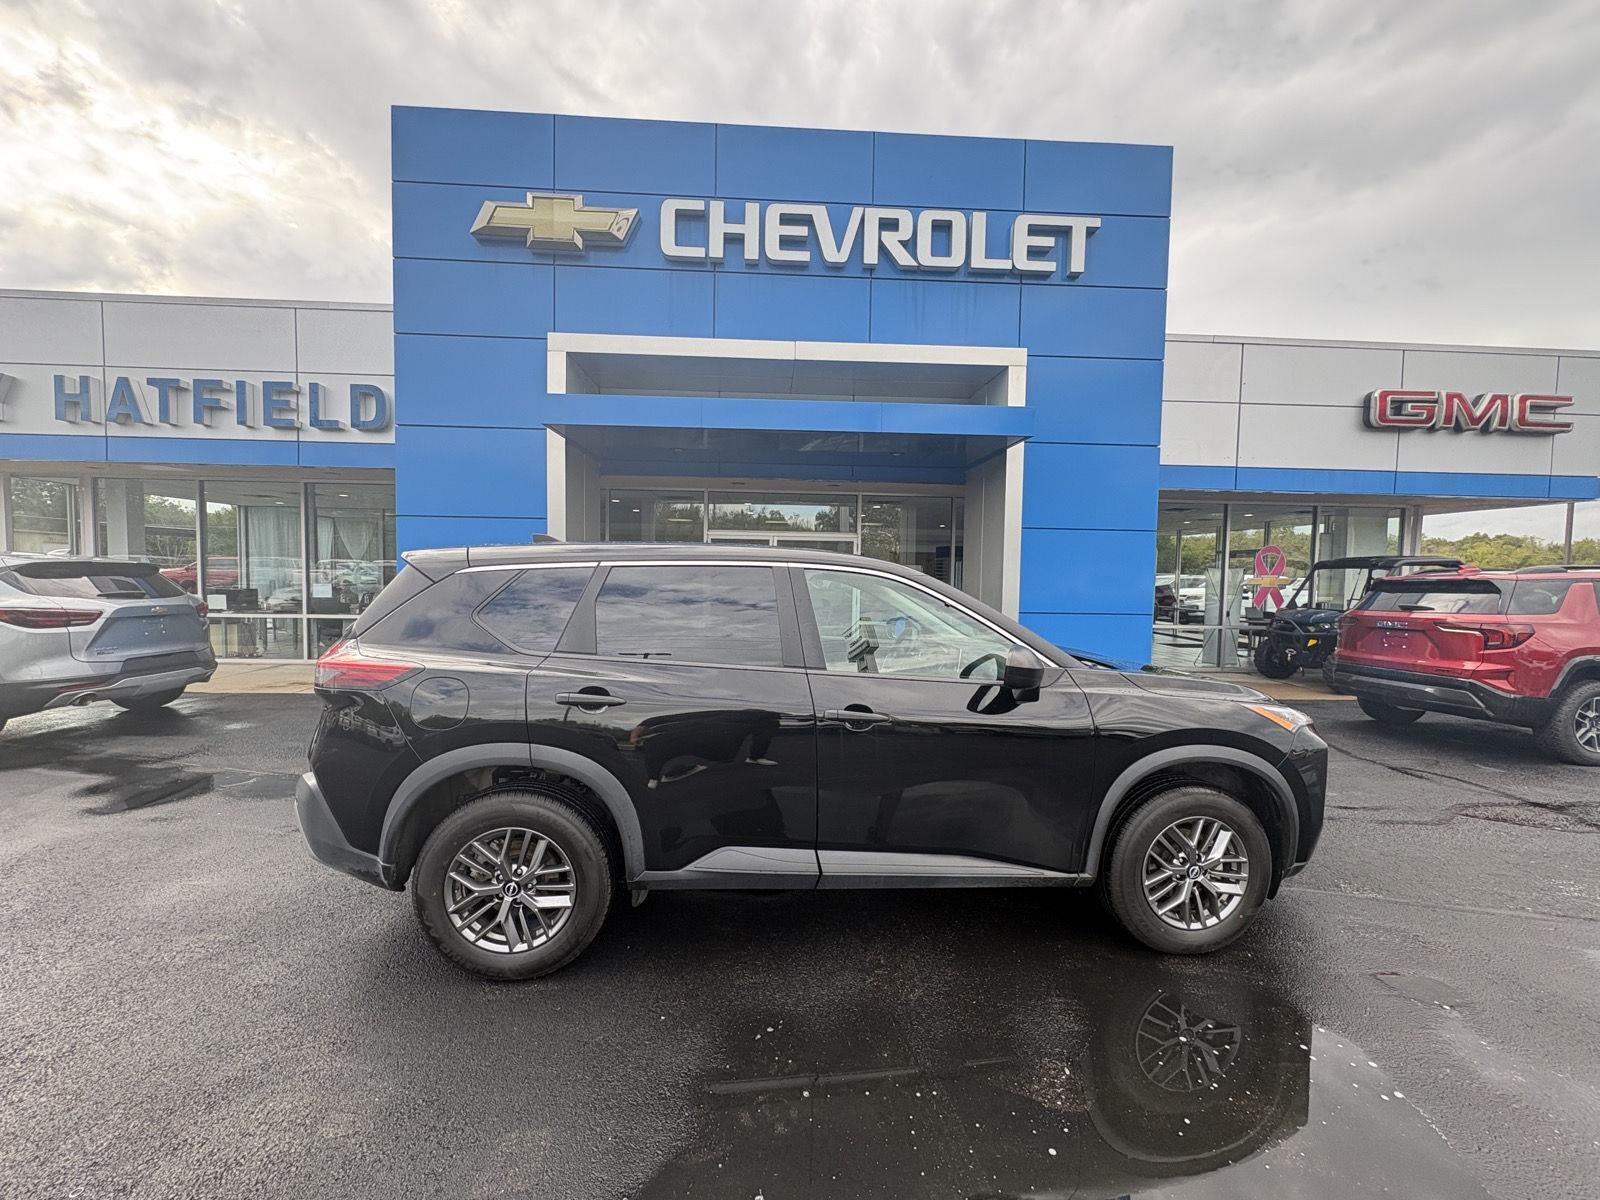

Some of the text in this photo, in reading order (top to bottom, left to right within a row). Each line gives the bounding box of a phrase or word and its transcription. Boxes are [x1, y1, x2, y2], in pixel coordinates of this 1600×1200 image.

[659, 197, 1102, 279] CHEVROLET
[53, 374, 391, 432] HATFIELD
[1367, 388, 1574, 434] GMC
